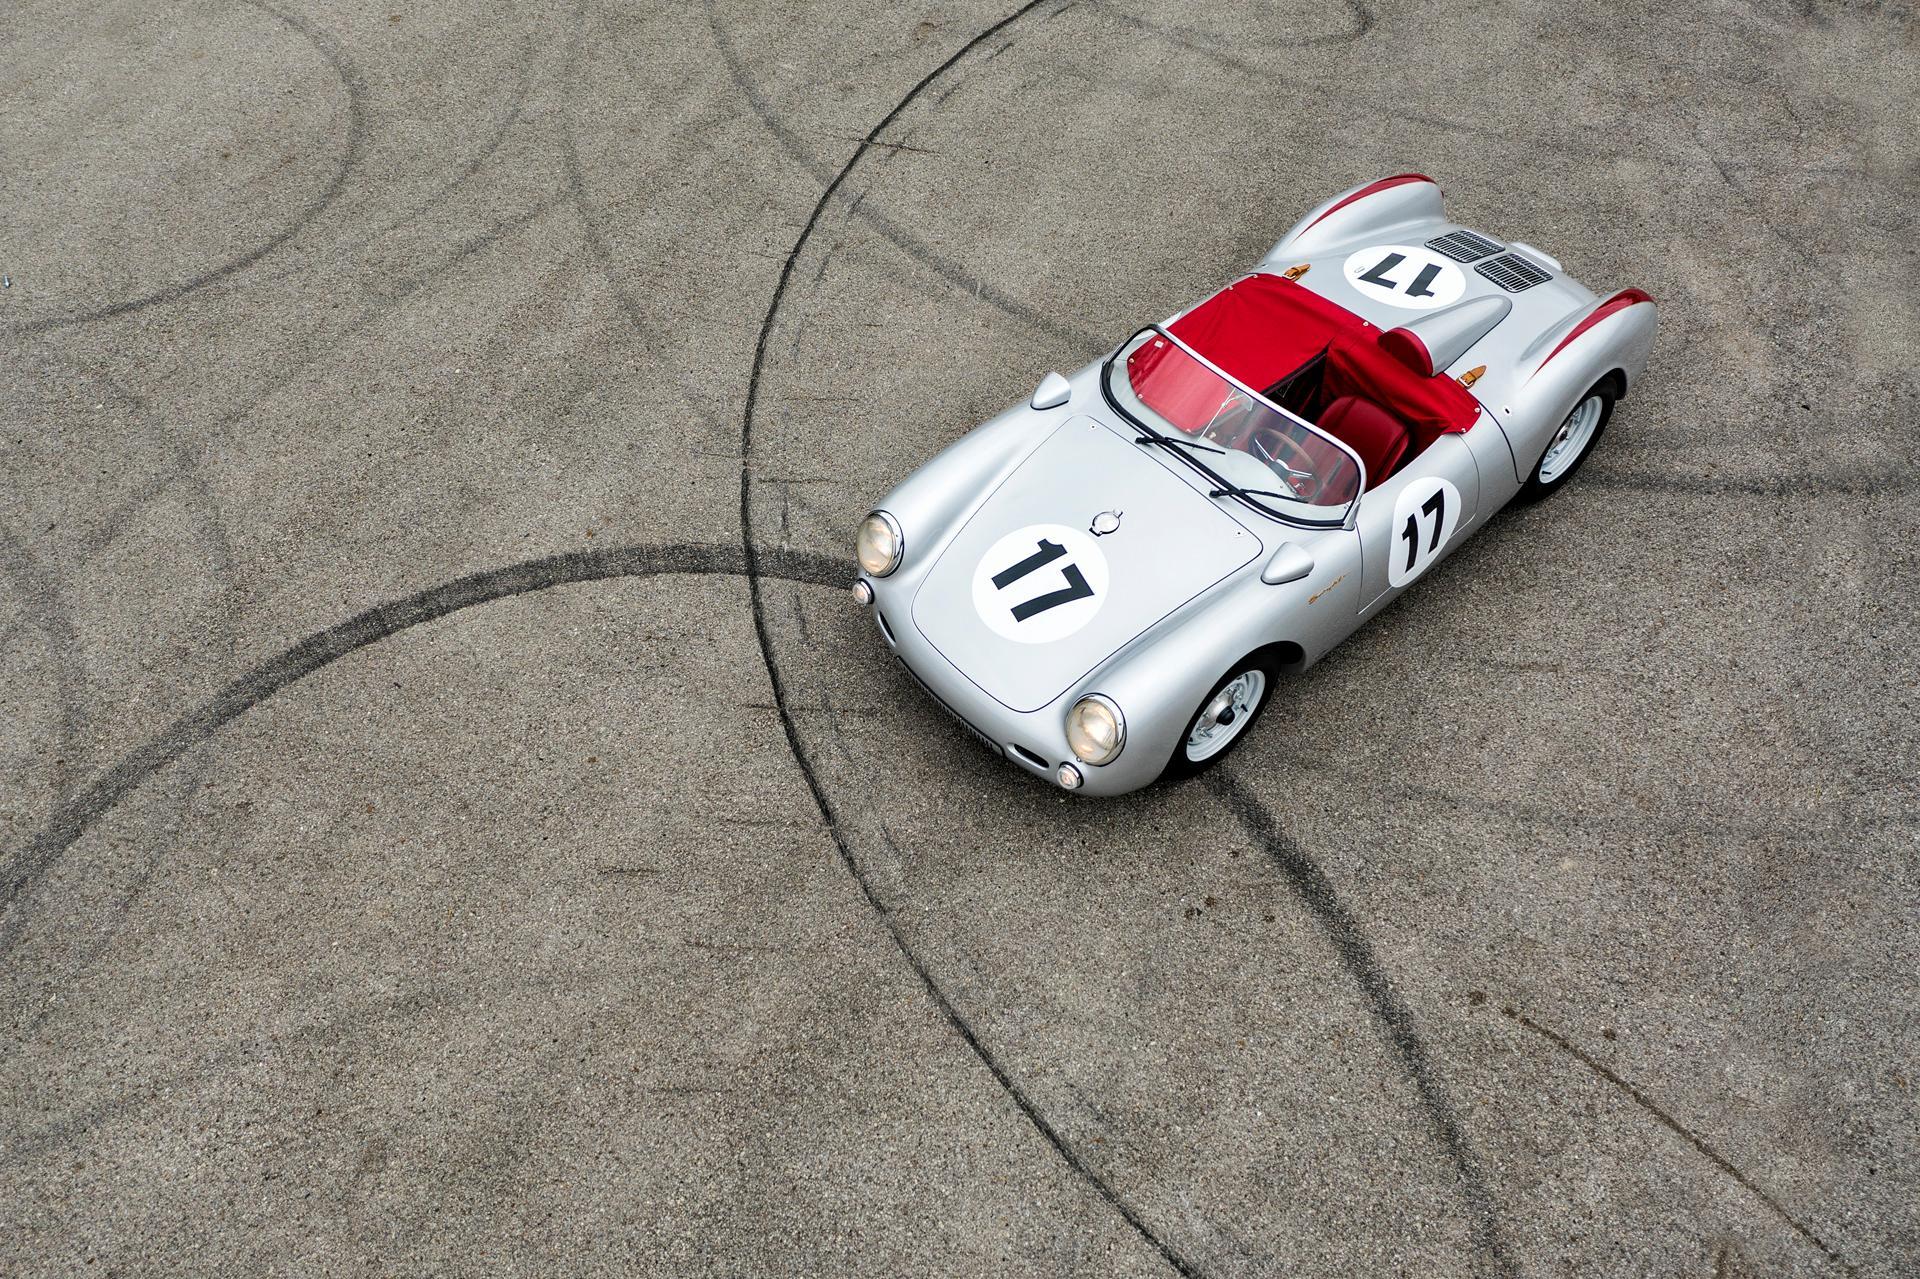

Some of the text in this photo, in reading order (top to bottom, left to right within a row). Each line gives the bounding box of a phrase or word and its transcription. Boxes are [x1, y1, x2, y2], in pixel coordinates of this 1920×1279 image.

[1357, 252, 1443, 298] 17
[1401, 487, 1445, 574] 17
[991, 538, 1095, 623] 17
